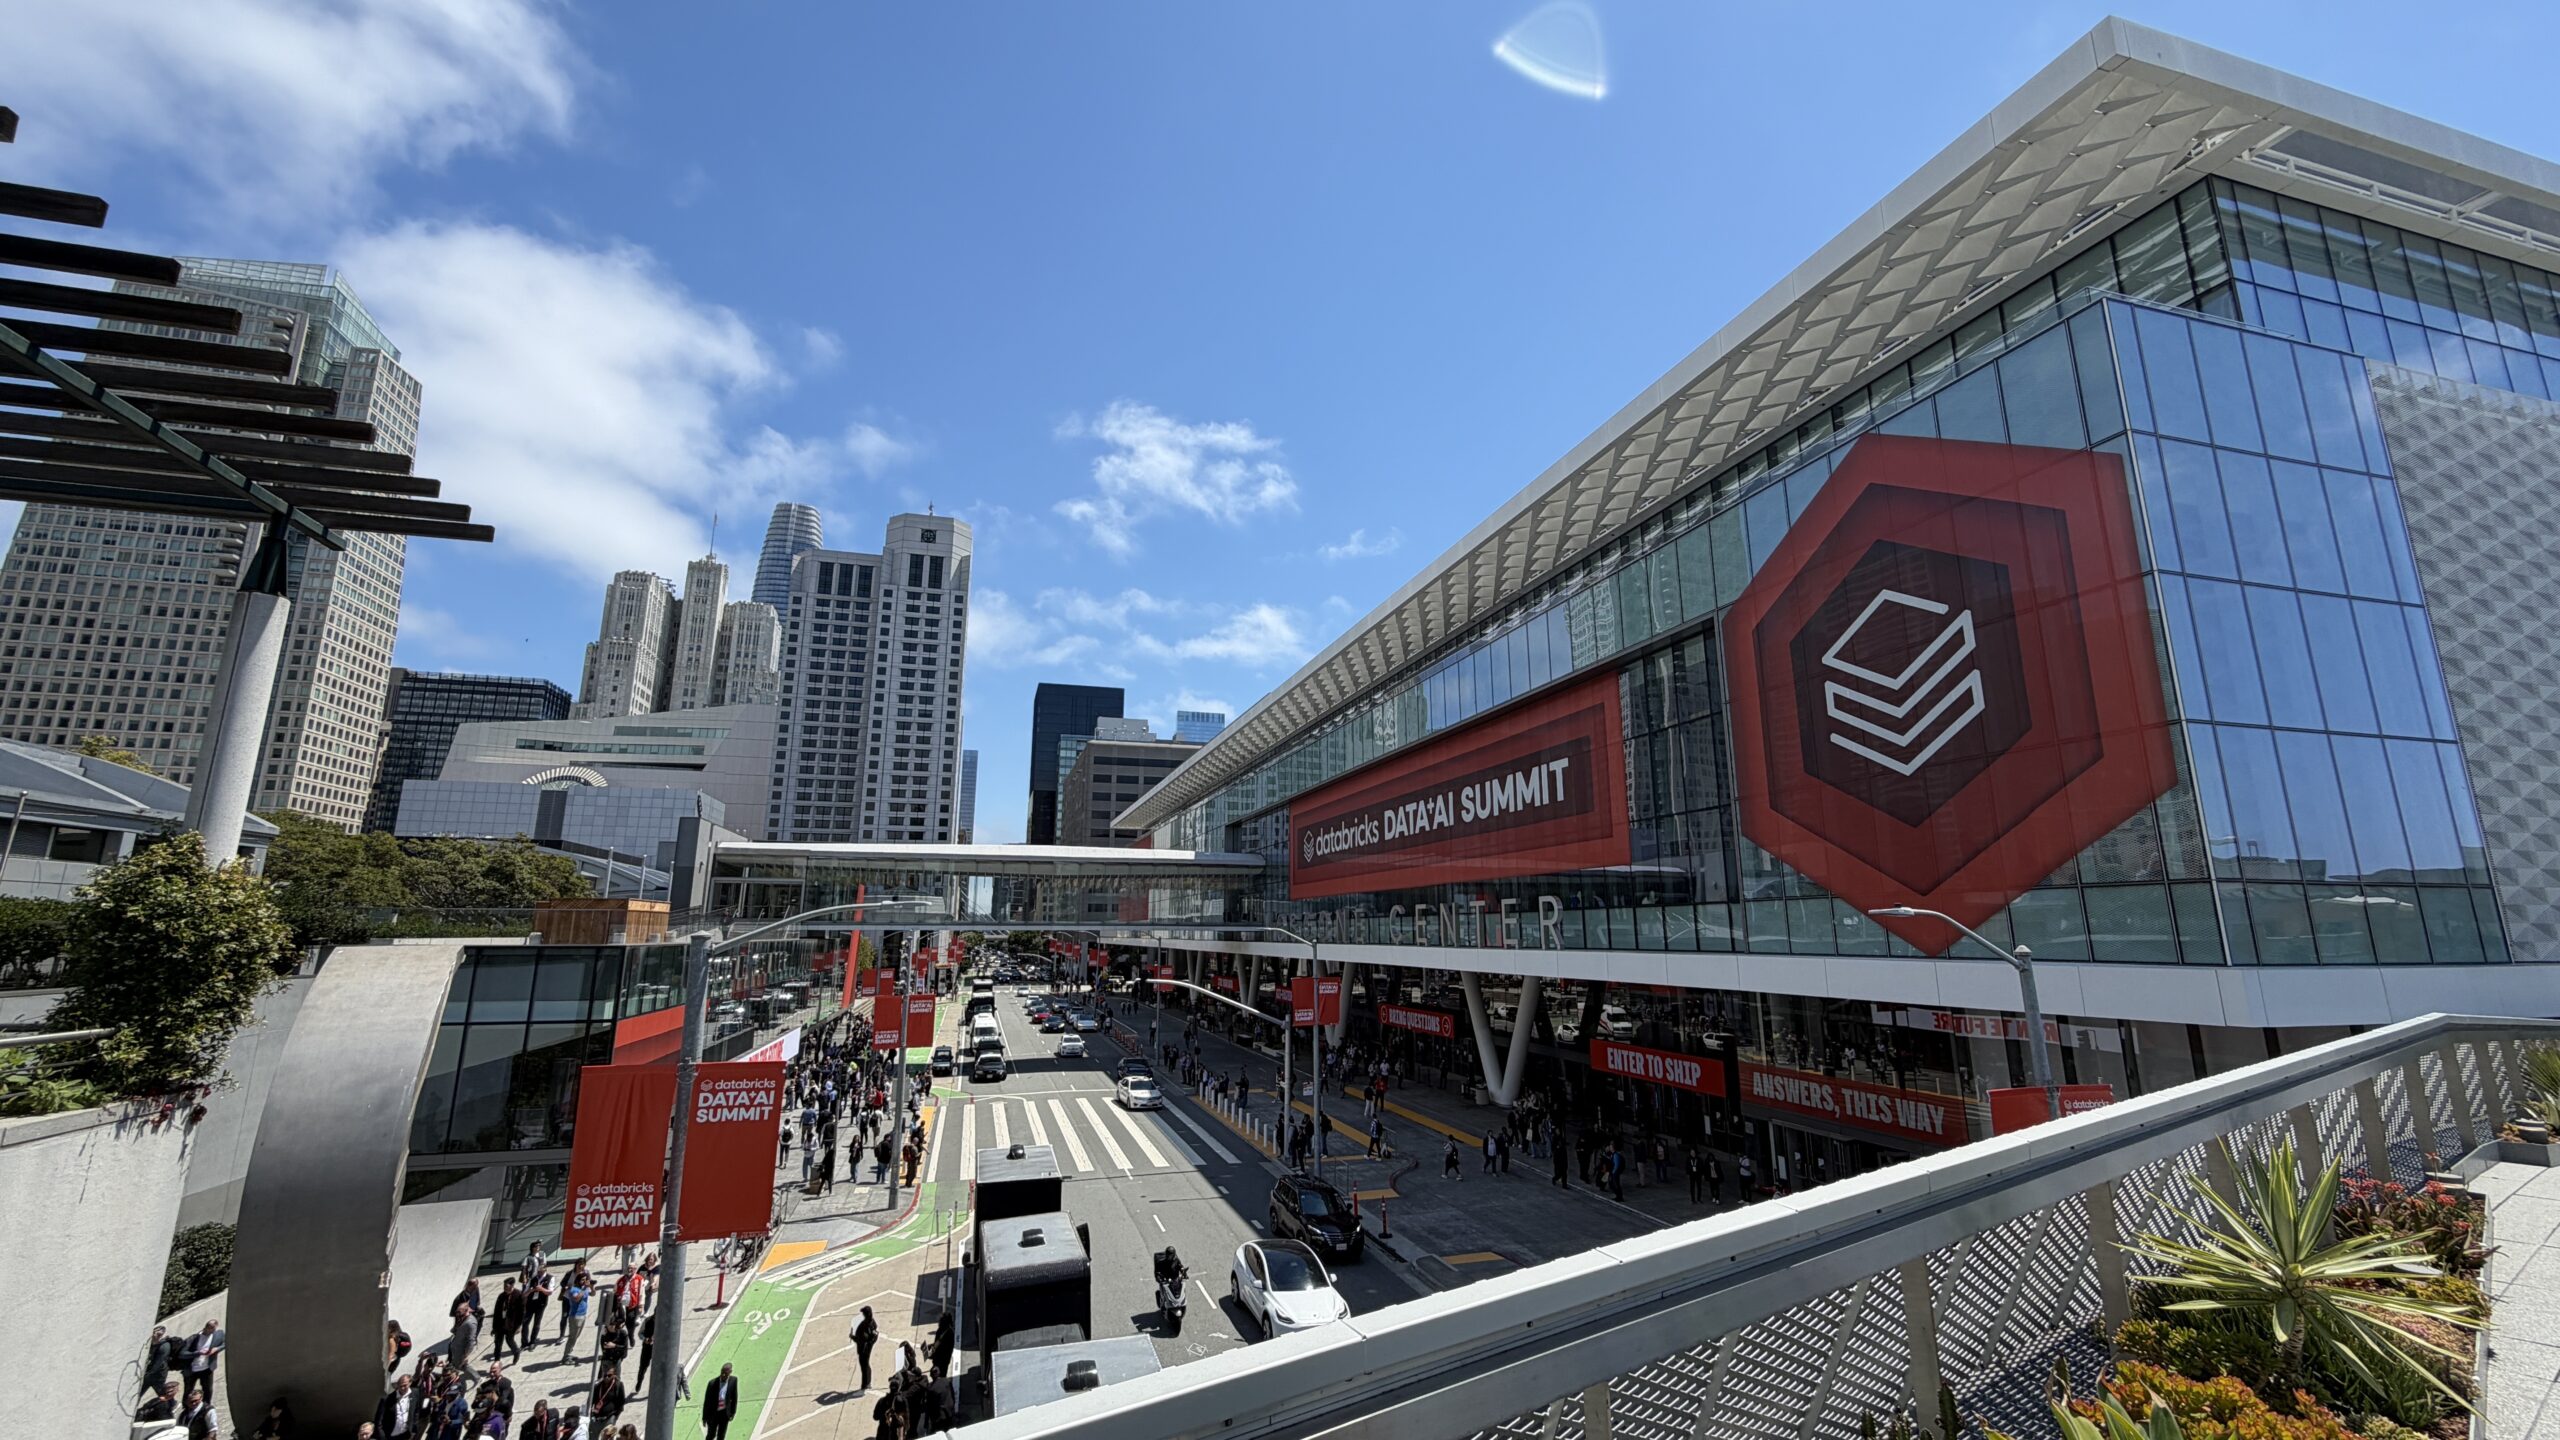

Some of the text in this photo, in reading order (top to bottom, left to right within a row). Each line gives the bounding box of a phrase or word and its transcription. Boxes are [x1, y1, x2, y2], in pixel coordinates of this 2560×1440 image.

[1316, 814, 1379, 856] databricks
[1461, 757, 1569, 823] SUMMIT
[1389, 895, 1564, 950] CENTER
[1406, 1011, 1440, 1032] QUESTIONS
[1607, 1047, 1700, 1086] ENTER TO SHIP
[715, 1078, 776, 1090] databricks
[1753, 1071, 1945, 1135] ANSWERS, THIS WAY
[696, 1106, 773, 1123] SUMMIT
[592, 1182, 654, 1194] databricks
[573, 1211, 652, 1230] SUMMIT
